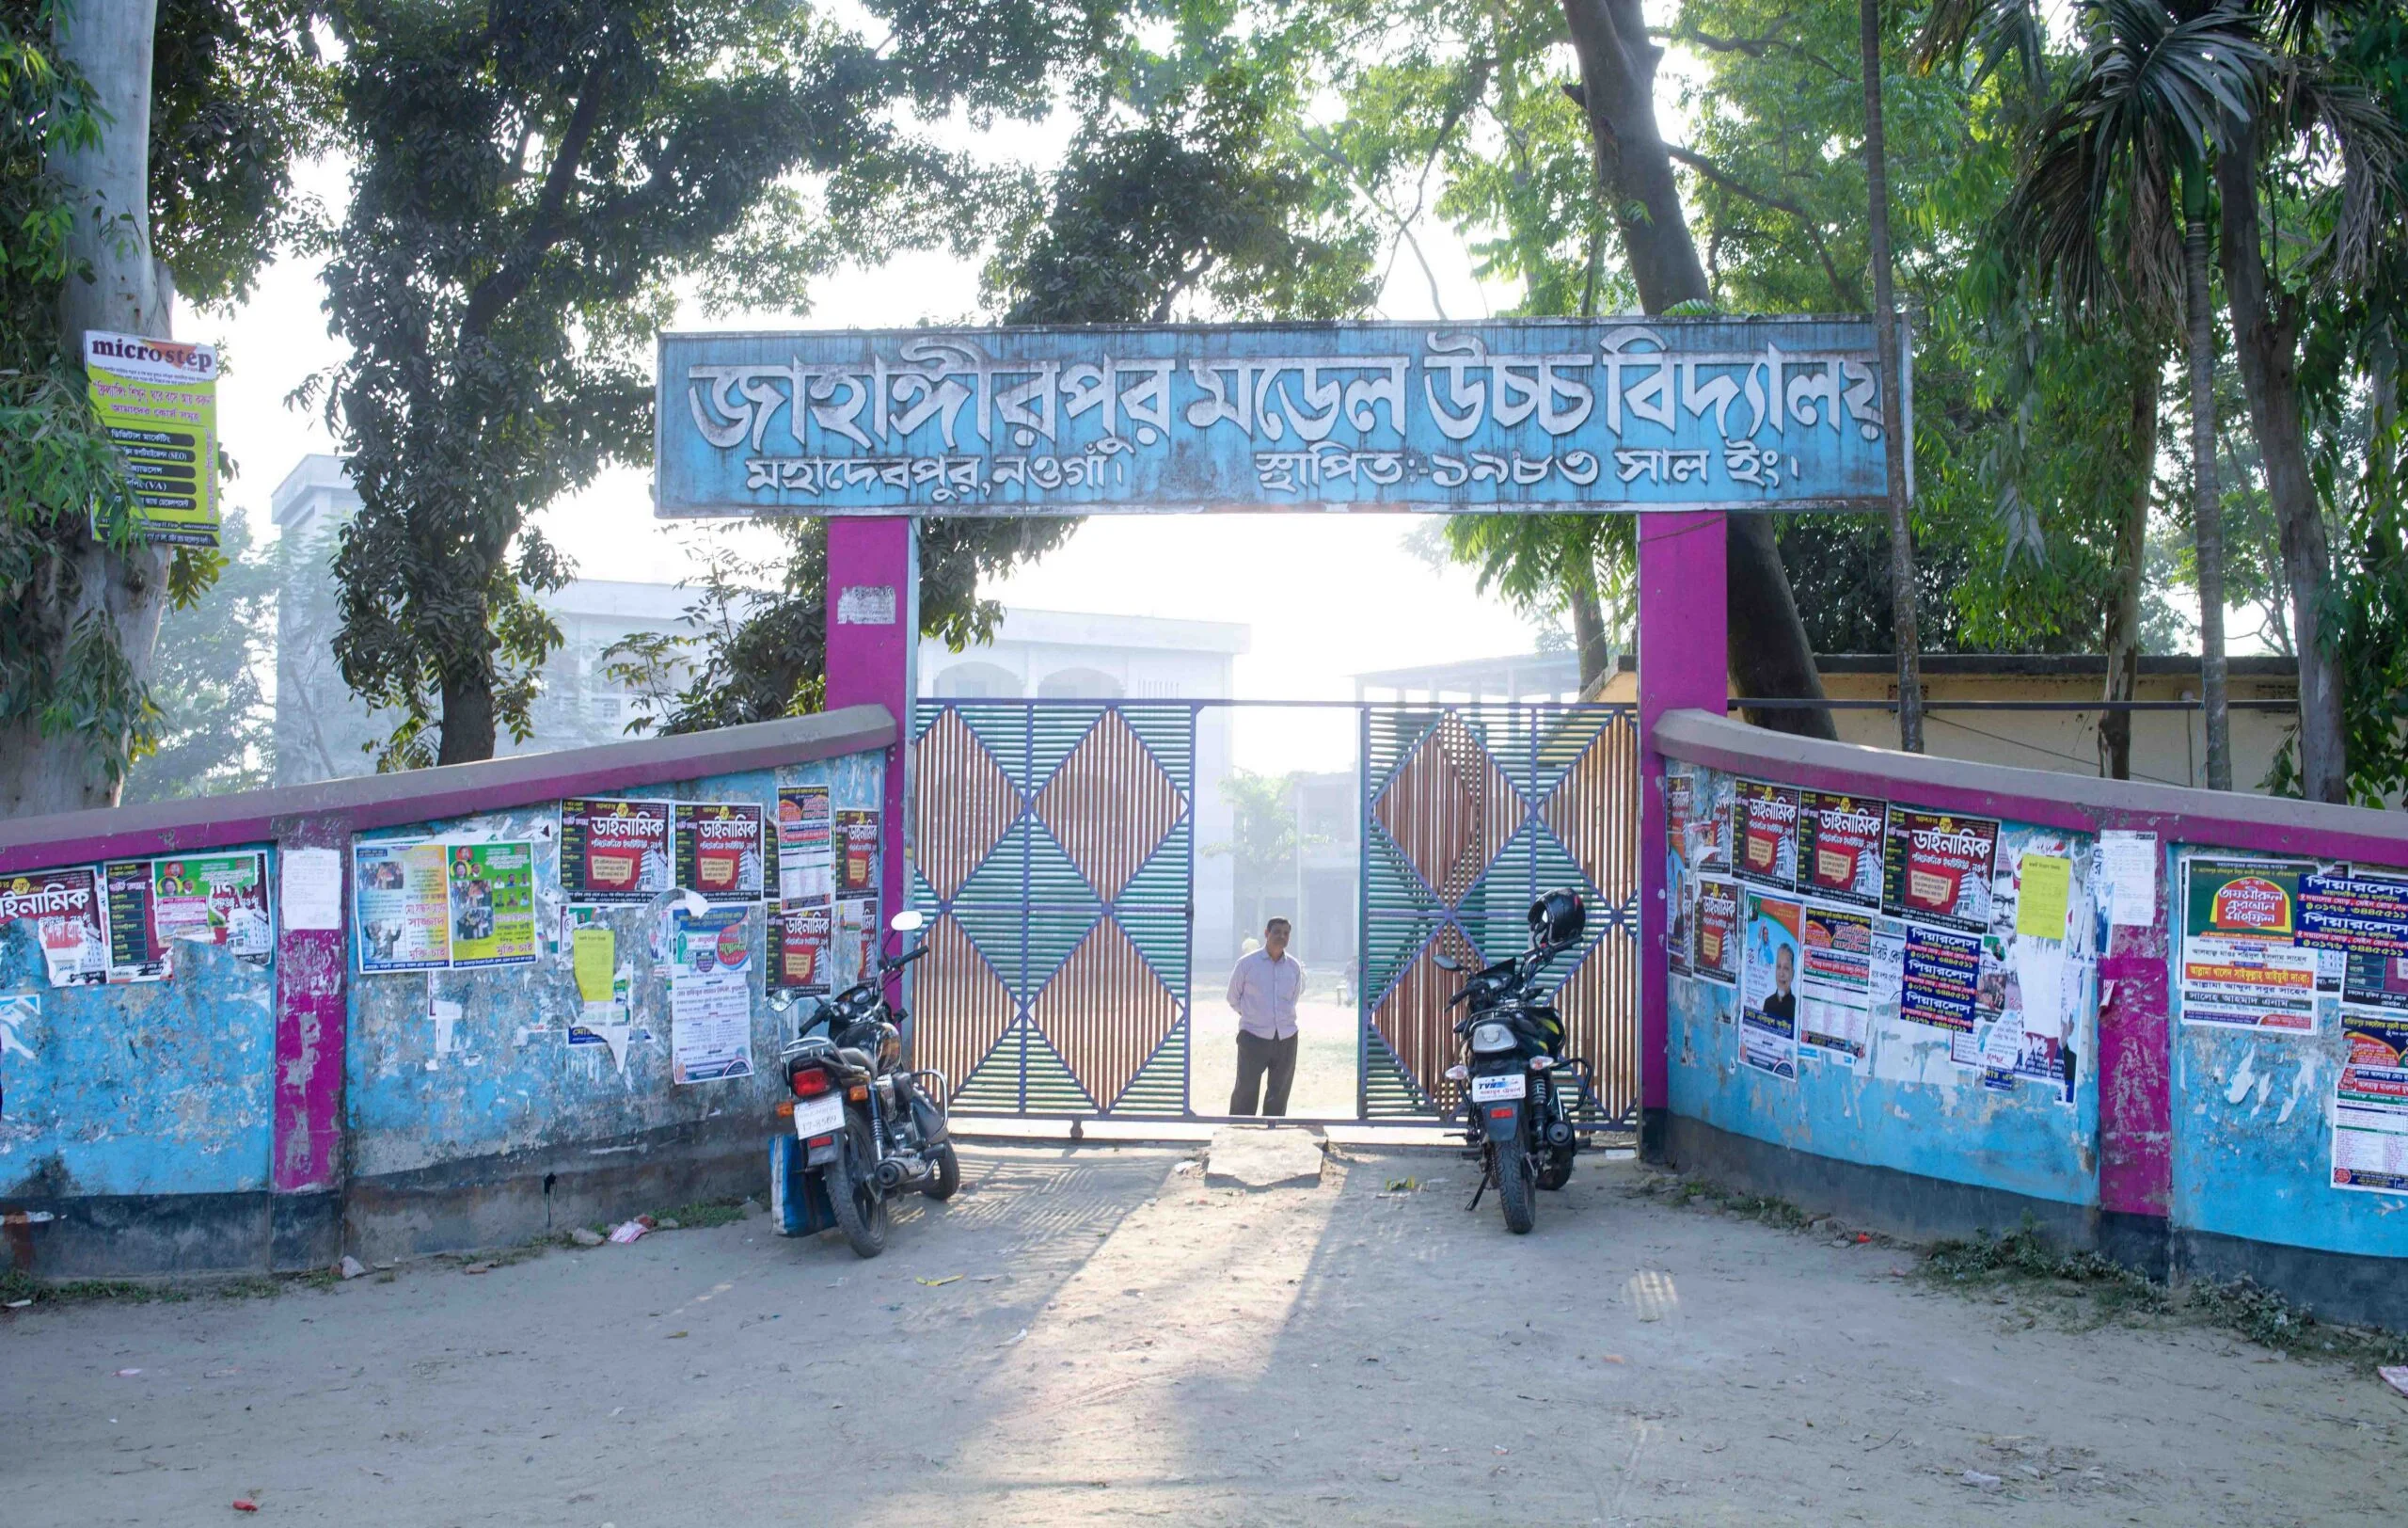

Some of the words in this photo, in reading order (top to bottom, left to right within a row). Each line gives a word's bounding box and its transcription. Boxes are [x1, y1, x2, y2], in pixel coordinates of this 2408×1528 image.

[689, 335, 1177, 454] জাহাঙ্গীরপুর
[1187, 353, 1411, 442] মডেল
[1421, 331, 1595, 439] উচ্চ
[1599, 325, 1886, 440] বিদ্যালয়
[1615, 446, 1708, 484] সাল
[145, 480, 167, 492] (VA)
[1750, 795, 1798, 823] ডাইনামিক
[591, 811, 665, 837] ডাইনামিক
[698, 813, 758, 839] ডাইনামিক
[1820, 806, 1881, 836] ডাইনামিক
[1911, 826, 1992, 859] ডাইনামিক
[408, 917, 445, 927] সাজ্জাদ
[784, 911, 830, 934] ডাইনামিক
[518, 942, 533, 952] চাই
[1911, 927, 1978, 949] পিয়ারলেস
[1908, 959, 1975, 982] পিয়ারলেস
[2190, 979, 2221, 991] আল্লামা
[1905, 991, 1972, 1014] পিয়ারলেস
